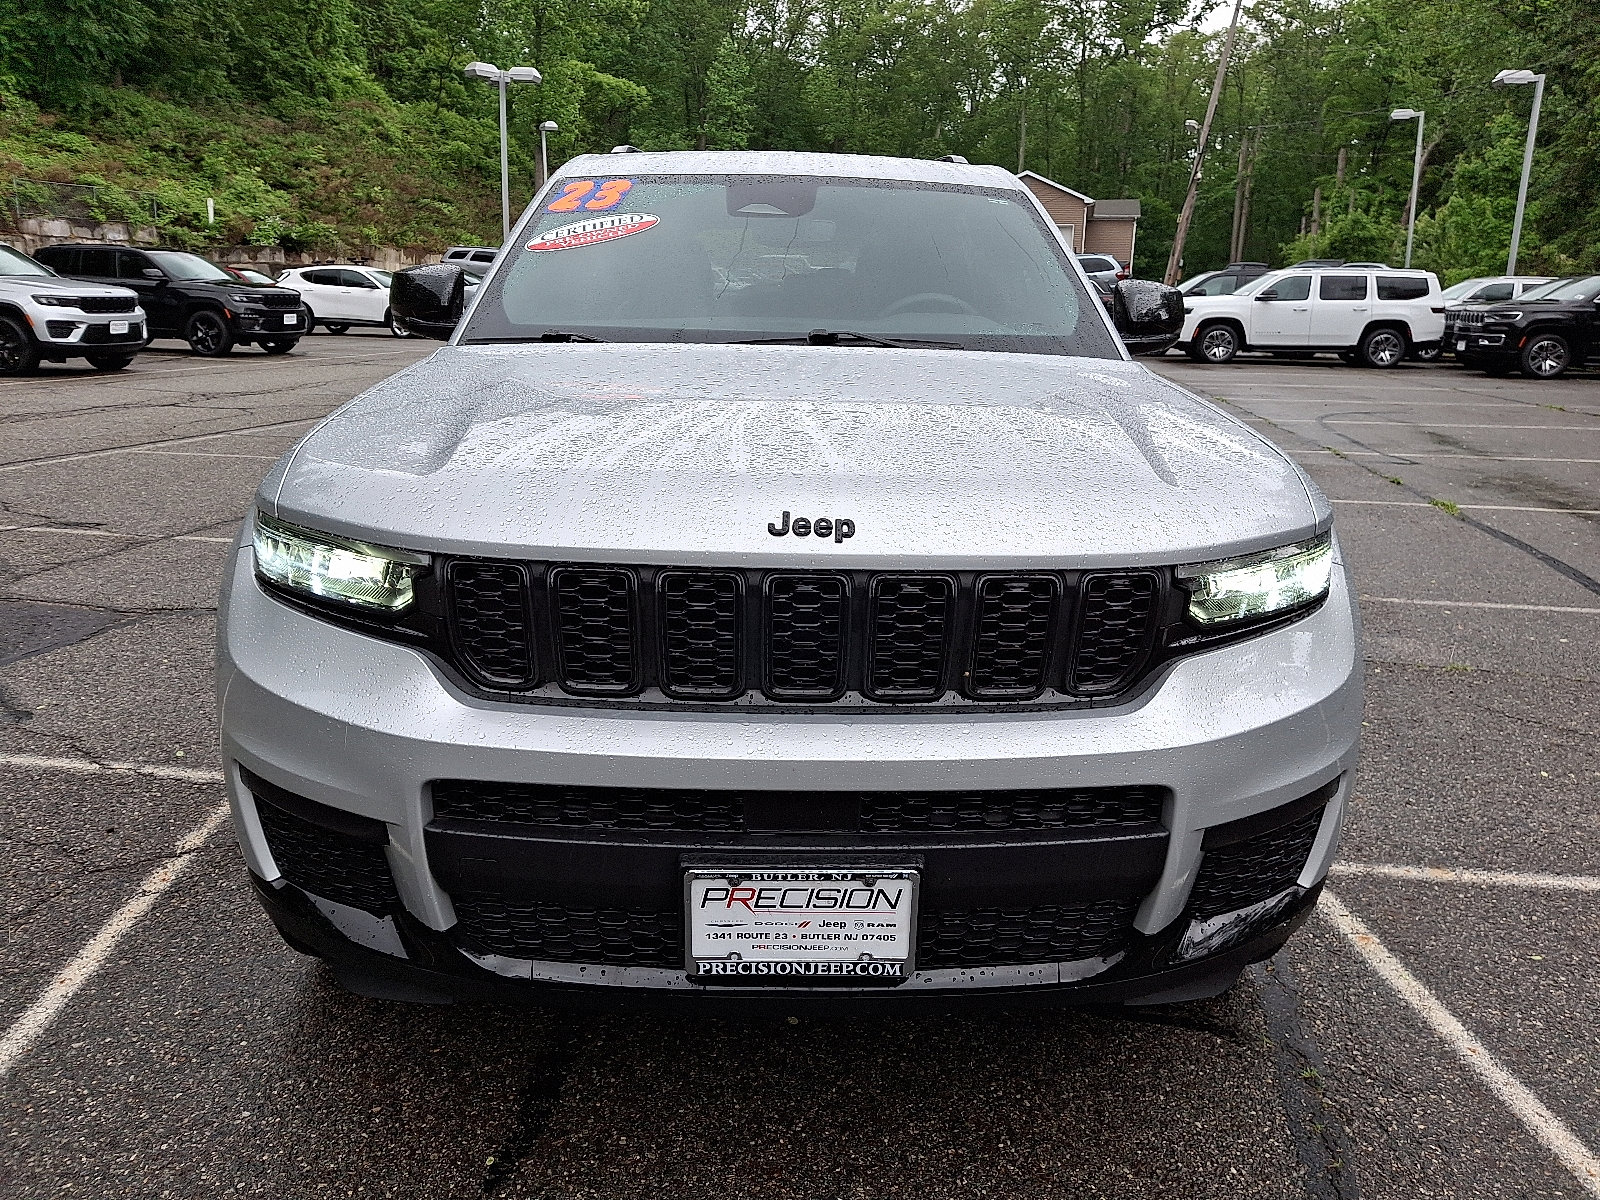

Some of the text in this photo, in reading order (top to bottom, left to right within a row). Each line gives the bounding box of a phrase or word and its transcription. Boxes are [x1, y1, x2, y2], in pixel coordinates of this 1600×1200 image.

[548, 178, 632, 213] 23
[540, 213, 644, 241] CERTIFIED
[767, 510, 856, 544] Jeep
[831, 873, 853, 882] NJ
[700, 887, 904, 912] PRECISION
[818, 919, 847, 930] Jeep
[705, 932, 897, 942] 1341 ROUTE 23 BUTLER NJ 07405
[698, 962, 902, 976] PRECISIONJEEP.COM
